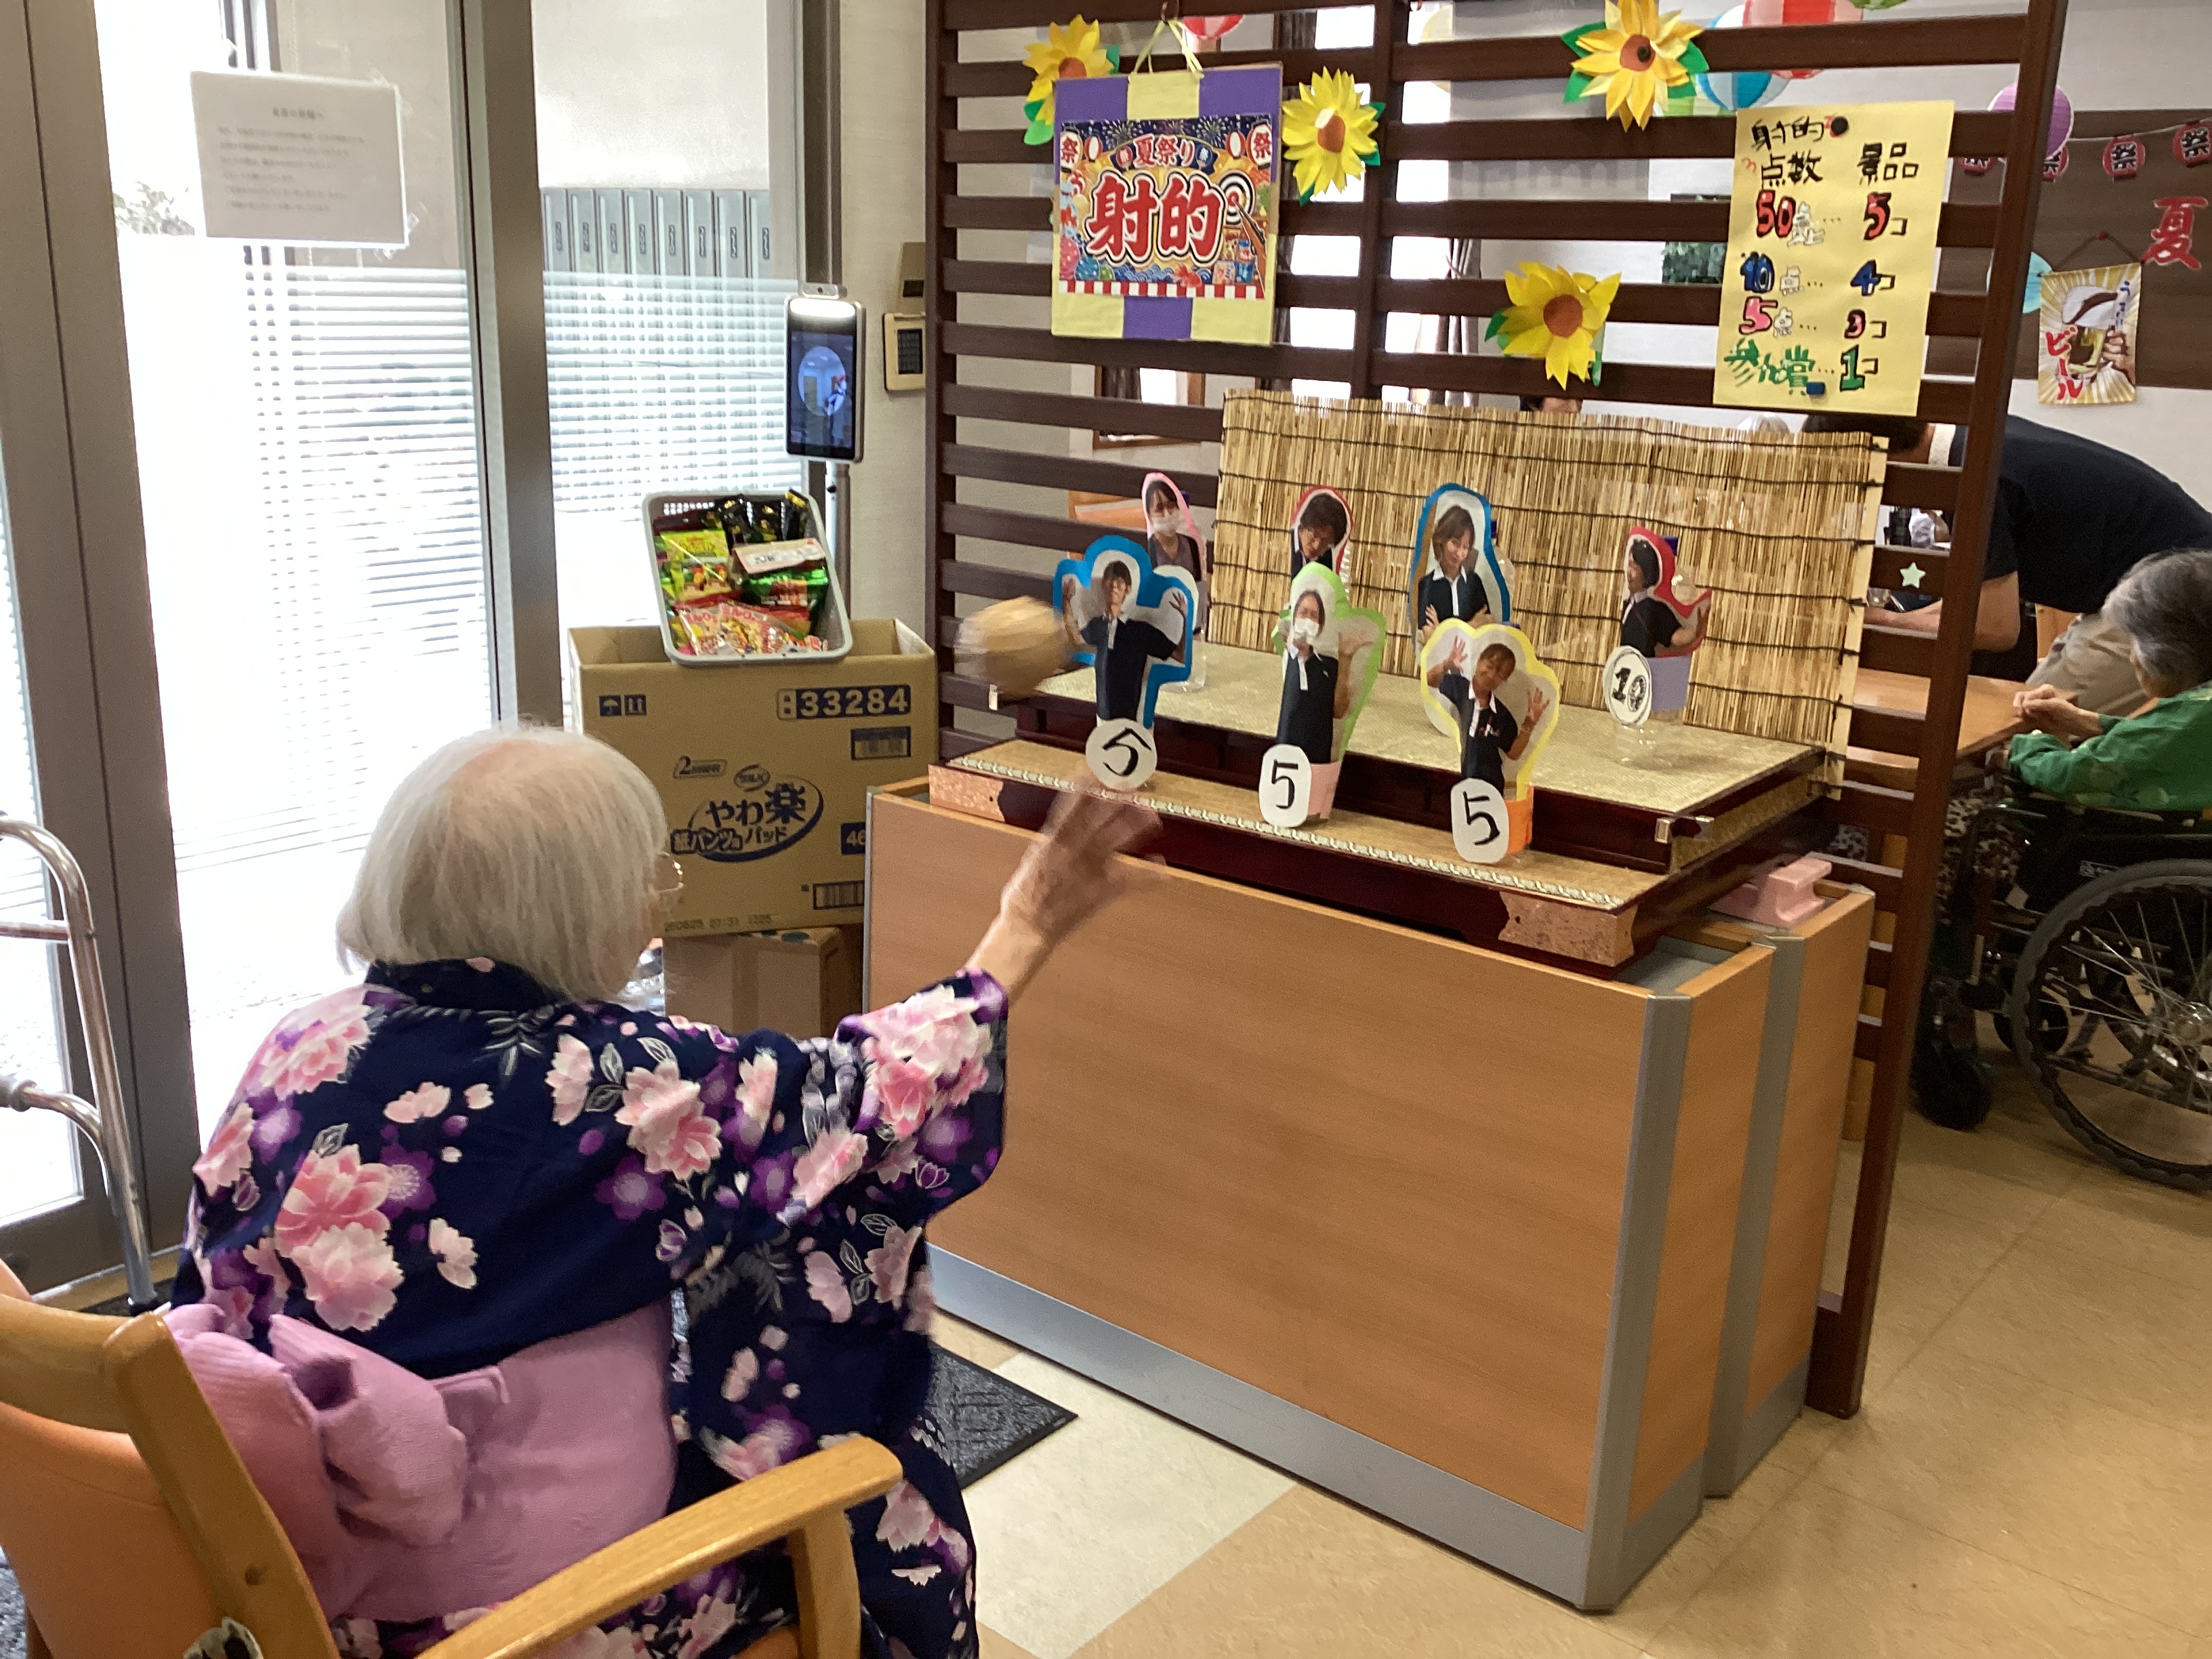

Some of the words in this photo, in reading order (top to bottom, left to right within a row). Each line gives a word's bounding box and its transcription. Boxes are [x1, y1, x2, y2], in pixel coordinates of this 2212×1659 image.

[1062, 138, 1078, 163] 祭
[1134, 134, 1194, 166] 夏祭り
[1254, 131, 1271, 159] 祭
[1751, 116, 1824, 151] 射的
[1761, 149, 1823, 186] 点数
[1857, 142, 1919, 185] 景品
[1086, 173, 1224, 261] 射的
[2142, 197, 2208, 269] 夏
[800, 688, 909, 717] 33284
[1612, 668, 1647, 712] 10
[705, 783, 805, 827] やわ楽
[1271, 759, 1298, 810] 5
[1462, 791, 1500, 846] 5
